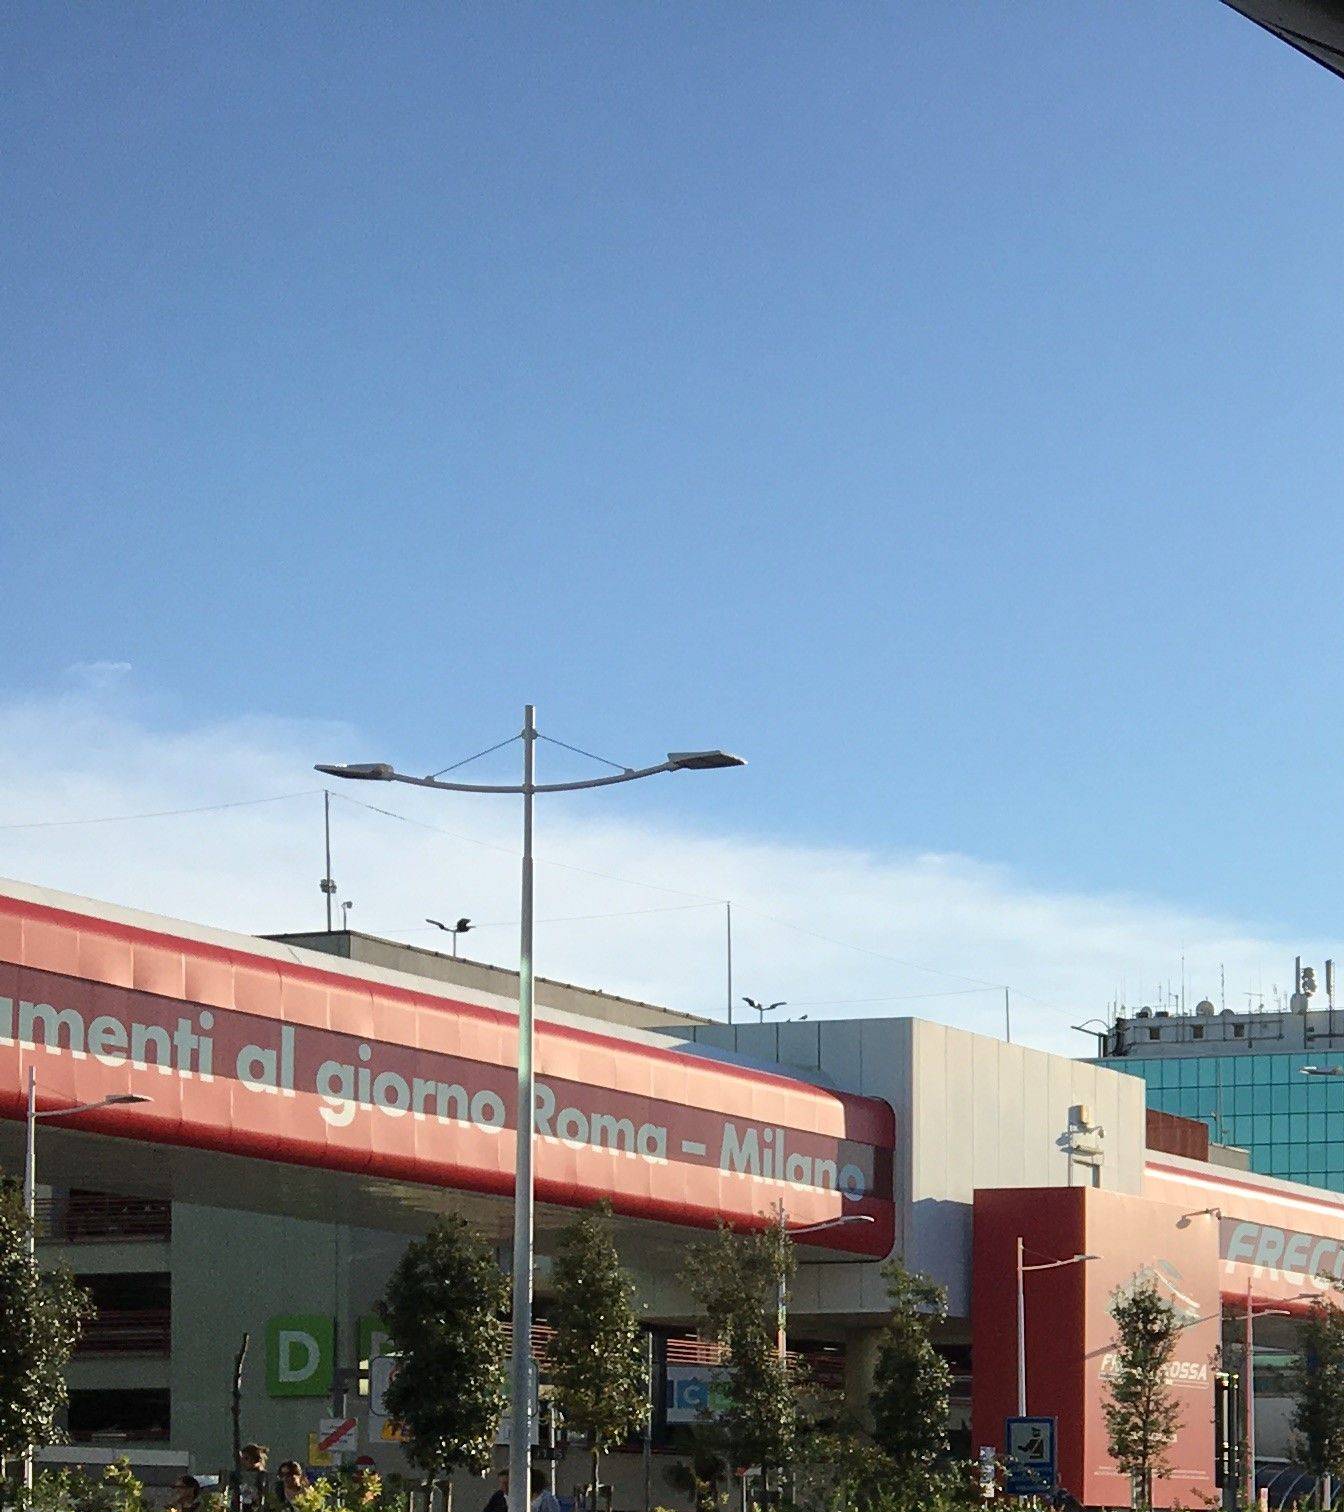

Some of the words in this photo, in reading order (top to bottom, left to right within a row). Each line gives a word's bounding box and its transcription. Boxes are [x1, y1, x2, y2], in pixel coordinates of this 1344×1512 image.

[236, 1025, 296, 1098] al
[316, 1043, 506, 1134] giorno
[532, 1081, 668, 1166] Roma
[720, 1122, 867, 1201] Milano
[278, 1331, 320, 1382] D
